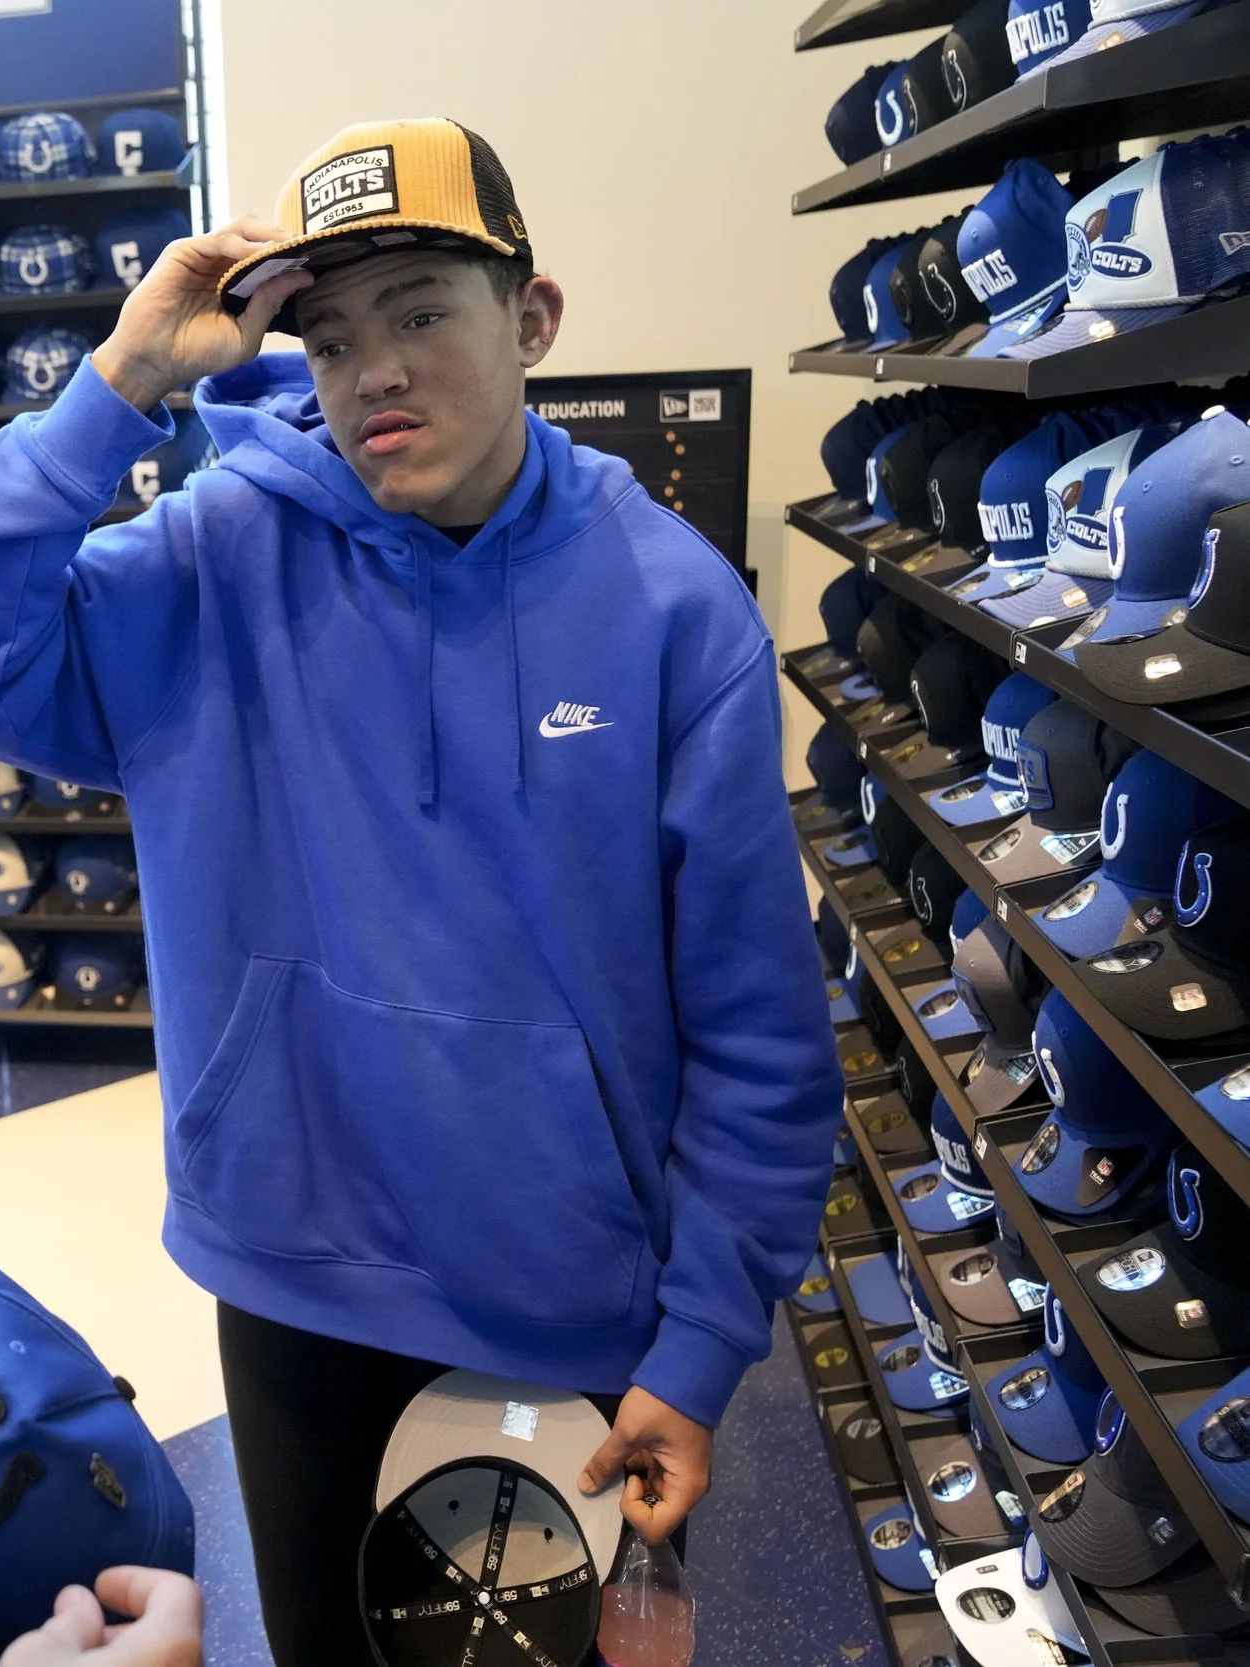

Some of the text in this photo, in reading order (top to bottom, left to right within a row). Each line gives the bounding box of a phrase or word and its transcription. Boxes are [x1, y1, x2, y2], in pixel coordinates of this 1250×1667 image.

[306, 156, 384, 193] INDIANAPOLIS
[307, 169, 385, 215] COLTS
[1092, 250, 1143, 273] COLTS
[539, 400, 626, 420] EDUCATION
[551, 701, 601, 726] NIKE
